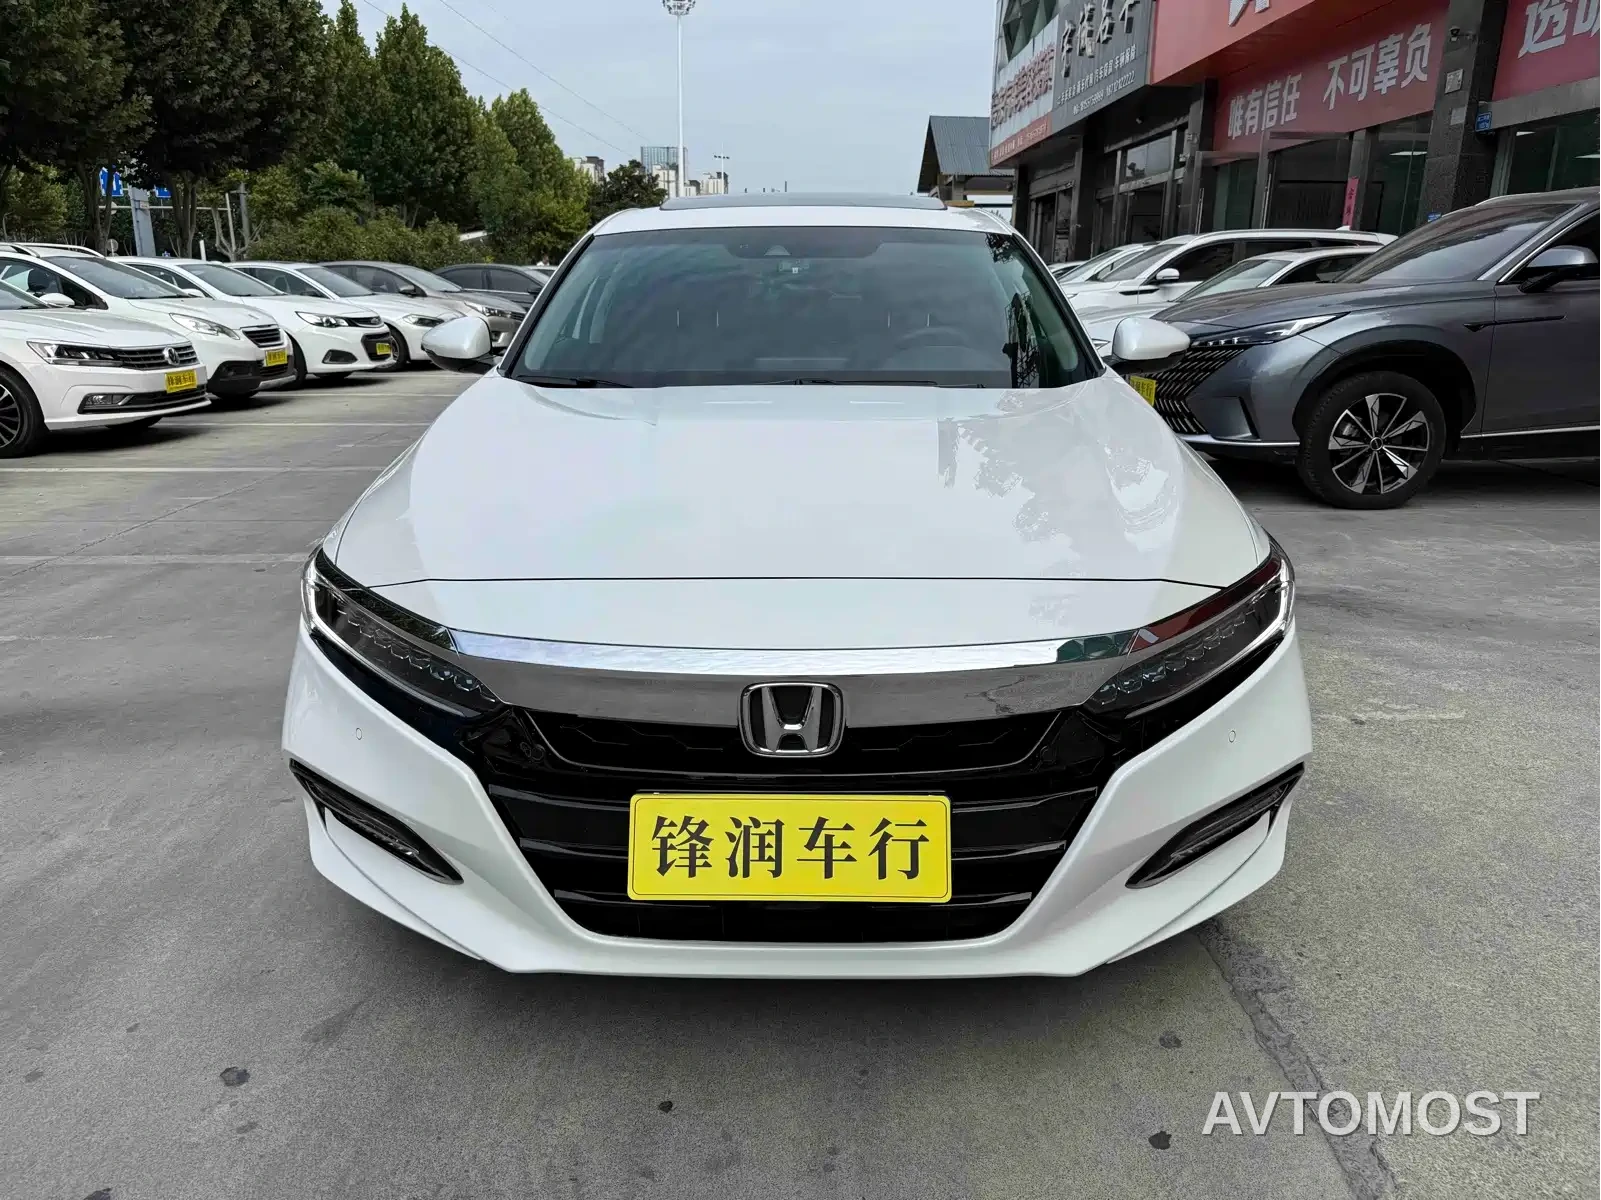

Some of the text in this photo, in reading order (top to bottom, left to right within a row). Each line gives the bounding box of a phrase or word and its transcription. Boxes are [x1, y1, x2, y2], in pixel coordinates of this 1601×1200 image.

[1518, 0, 1601, 59] 透
[1228, 22, 1432, 140] 唯有信任 不可辜负
[651, 814, 931, 880] 锋润车行
